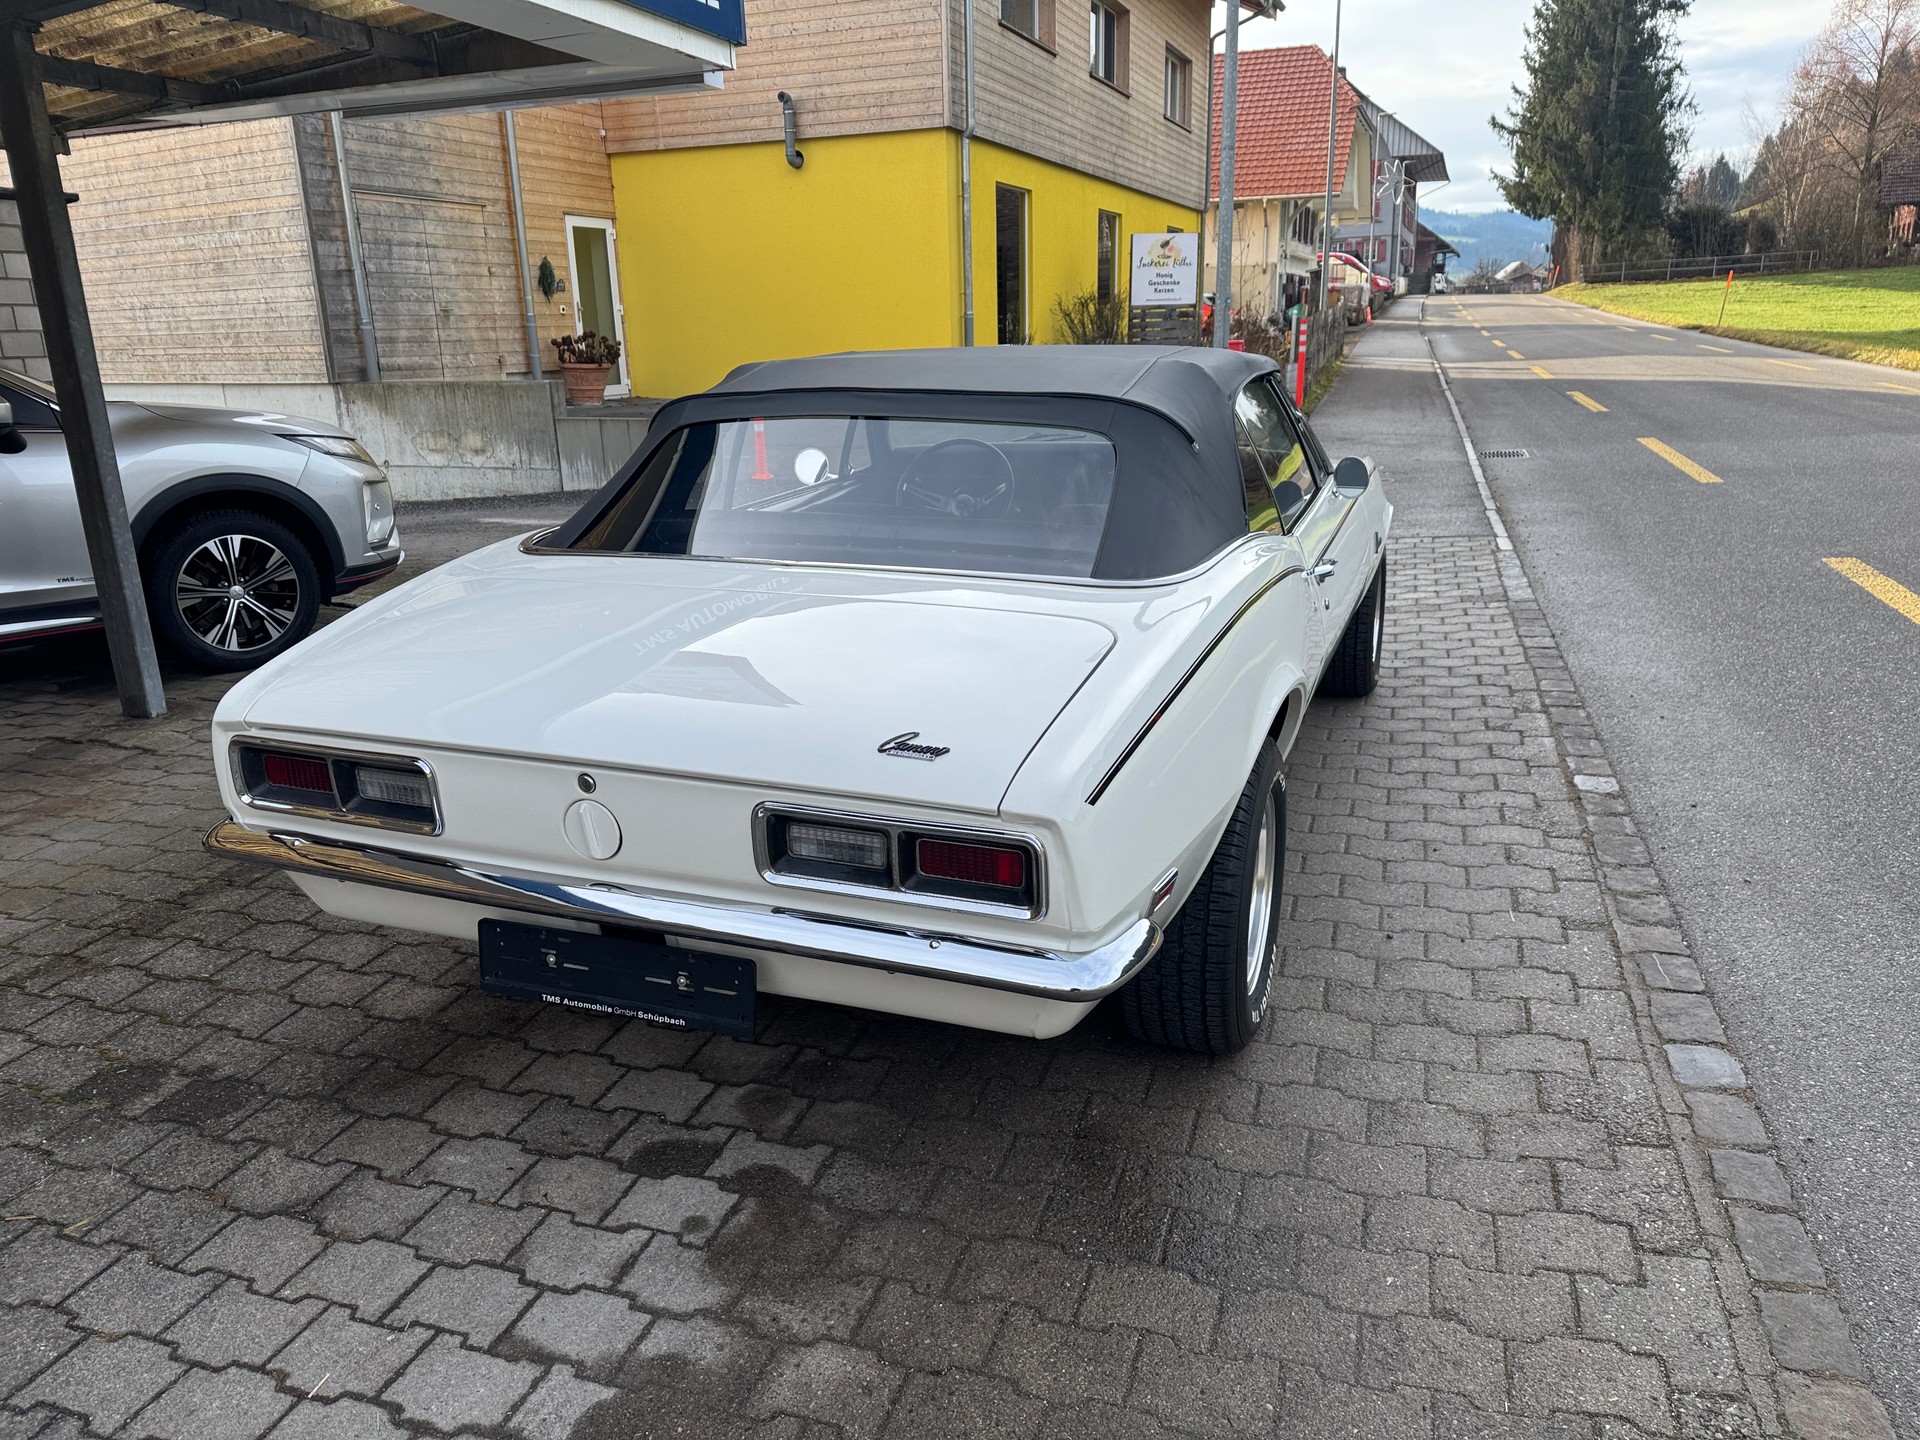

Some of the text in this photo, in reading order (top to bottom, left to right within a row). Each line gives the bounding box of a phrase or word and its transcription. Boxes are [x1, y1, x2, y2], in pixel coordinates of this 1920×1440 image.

[1155, 271, 1173, 279] Honig
[541, 993, 686, 1027] TMS Automobile GmbH Schüpbach
